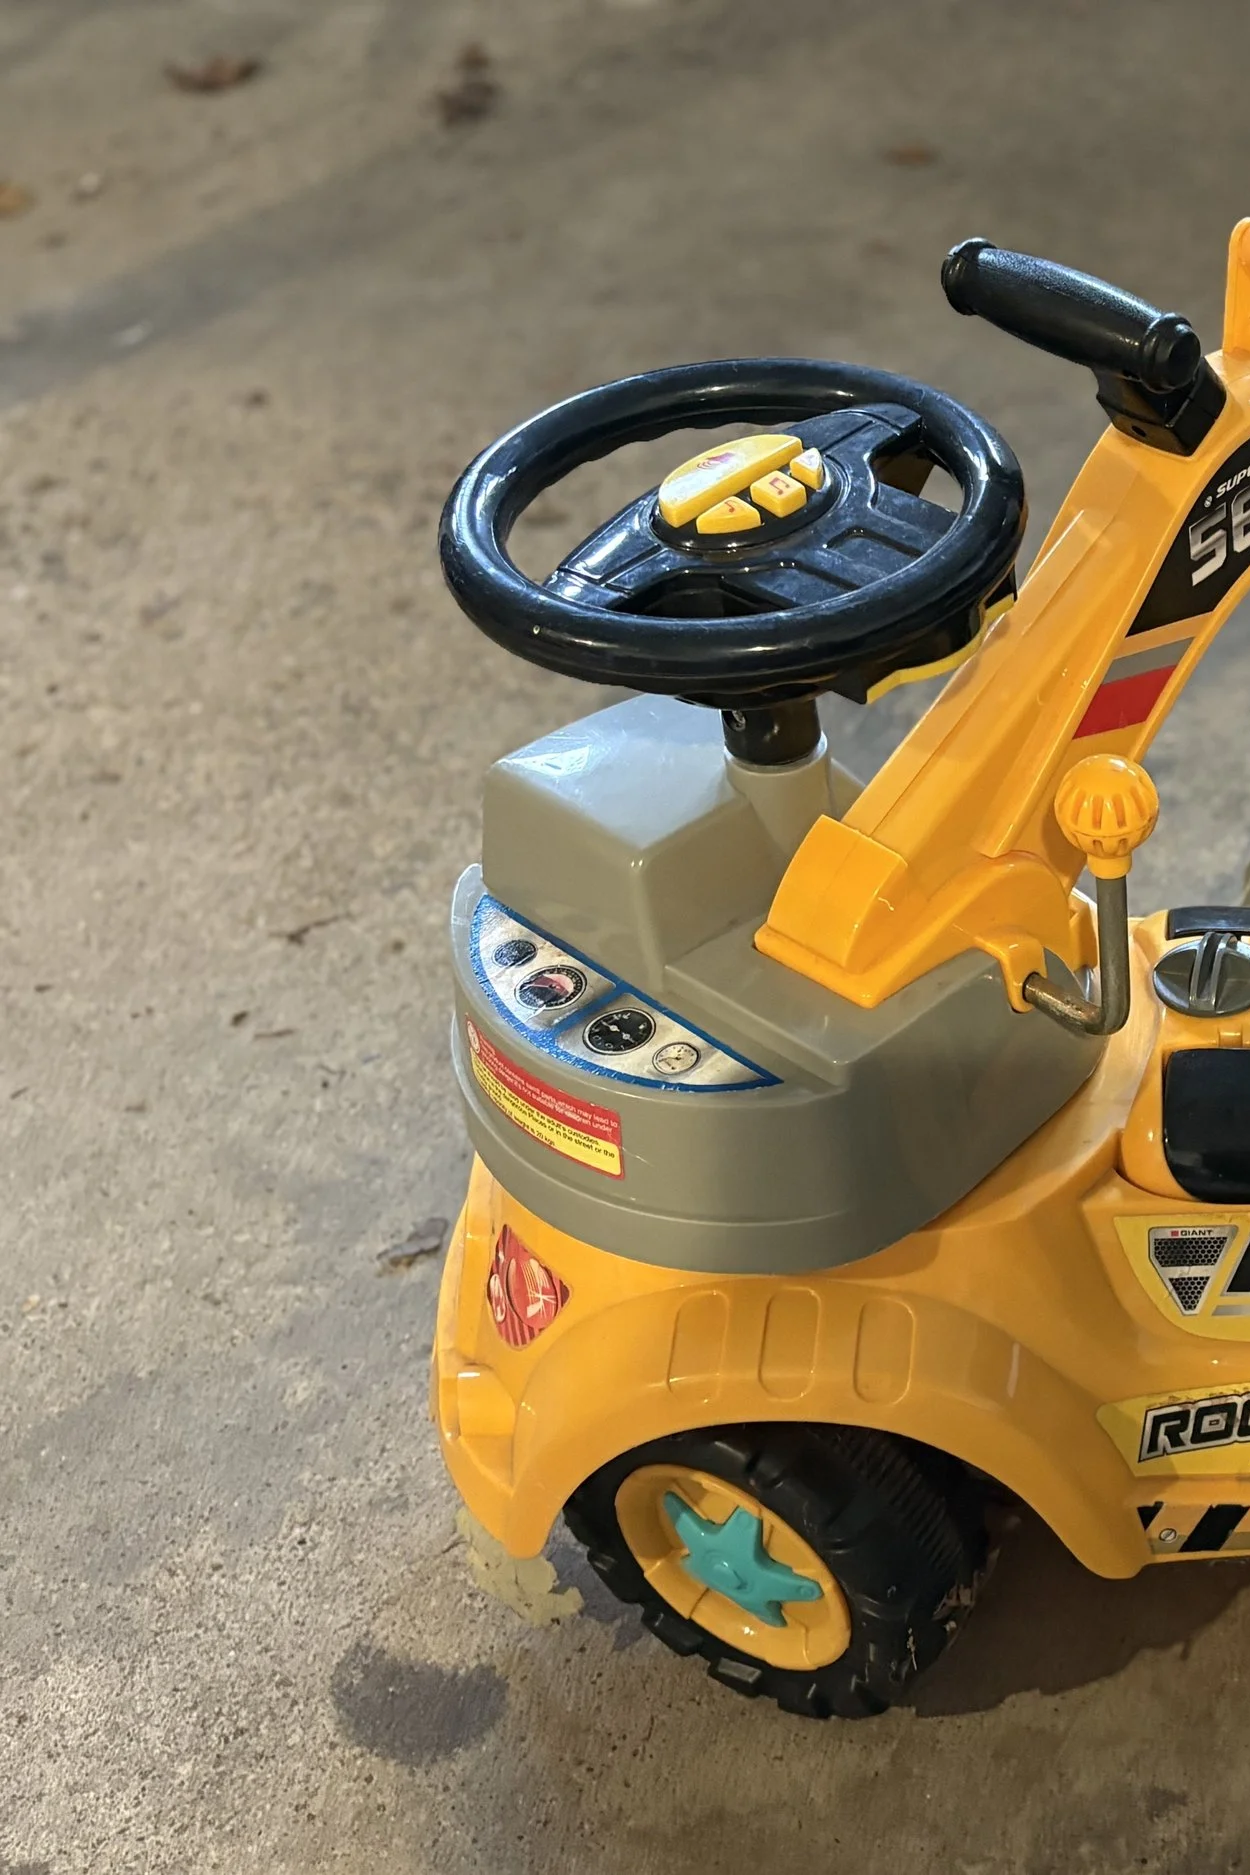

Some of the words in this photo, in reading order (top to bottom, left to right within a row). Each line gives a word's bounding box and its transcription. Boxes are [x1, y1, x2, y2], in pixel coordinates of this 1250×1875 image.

[593, 1113, 610, 1125] lead
[610, 1120, 619, 1128] to
[603, 1148, 616, 1159] the
[1180, 1229, 1214, 1237] GIANT
